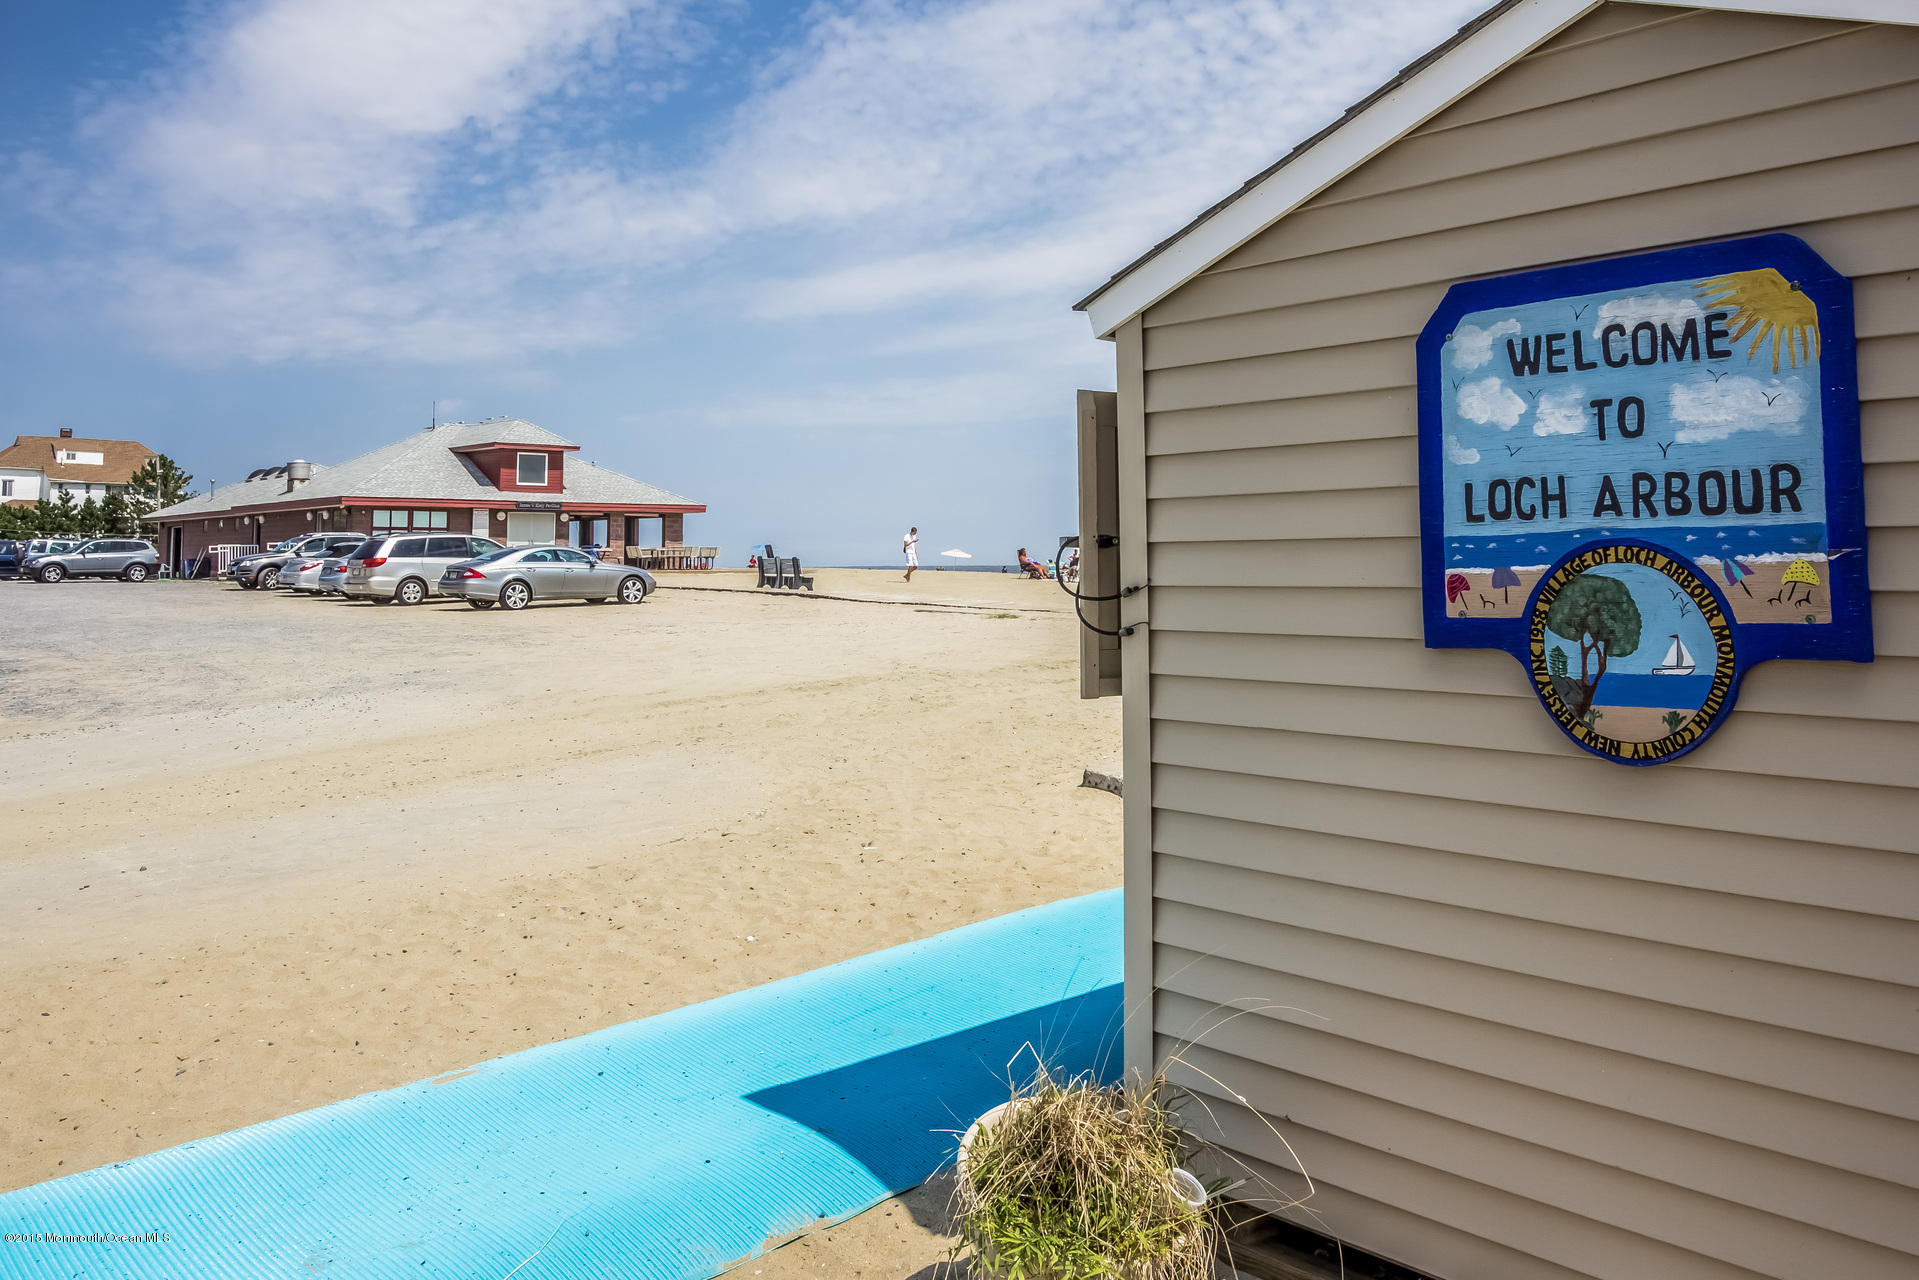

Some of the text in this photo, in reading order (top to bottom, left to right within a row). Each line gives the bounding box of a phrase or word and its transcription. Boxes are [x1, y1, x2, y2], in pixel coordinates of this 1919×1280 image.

[1506, 313, 1732, 377] WELCOME
[1590, 396, 1645, 440] TO
[1464, 463, 1802, 523] LOCH ARBOUR
[1539, 553, 1594, 605] VILLAGE
[1591, 546, 1614, 566] OF
[1615, 546, 1658, 566] LOCH
[1661, 558, 1721, 625] ARBOUR
[1530, 609, 1548, 642] 1958
[1693, 624, 1735, 730] MONMOUTH
[1537, 675, 1584, 730] JERSEY
[1584, 732, 1621, 758] NEW
[1631, 724, 1697, 760] COUNTY
